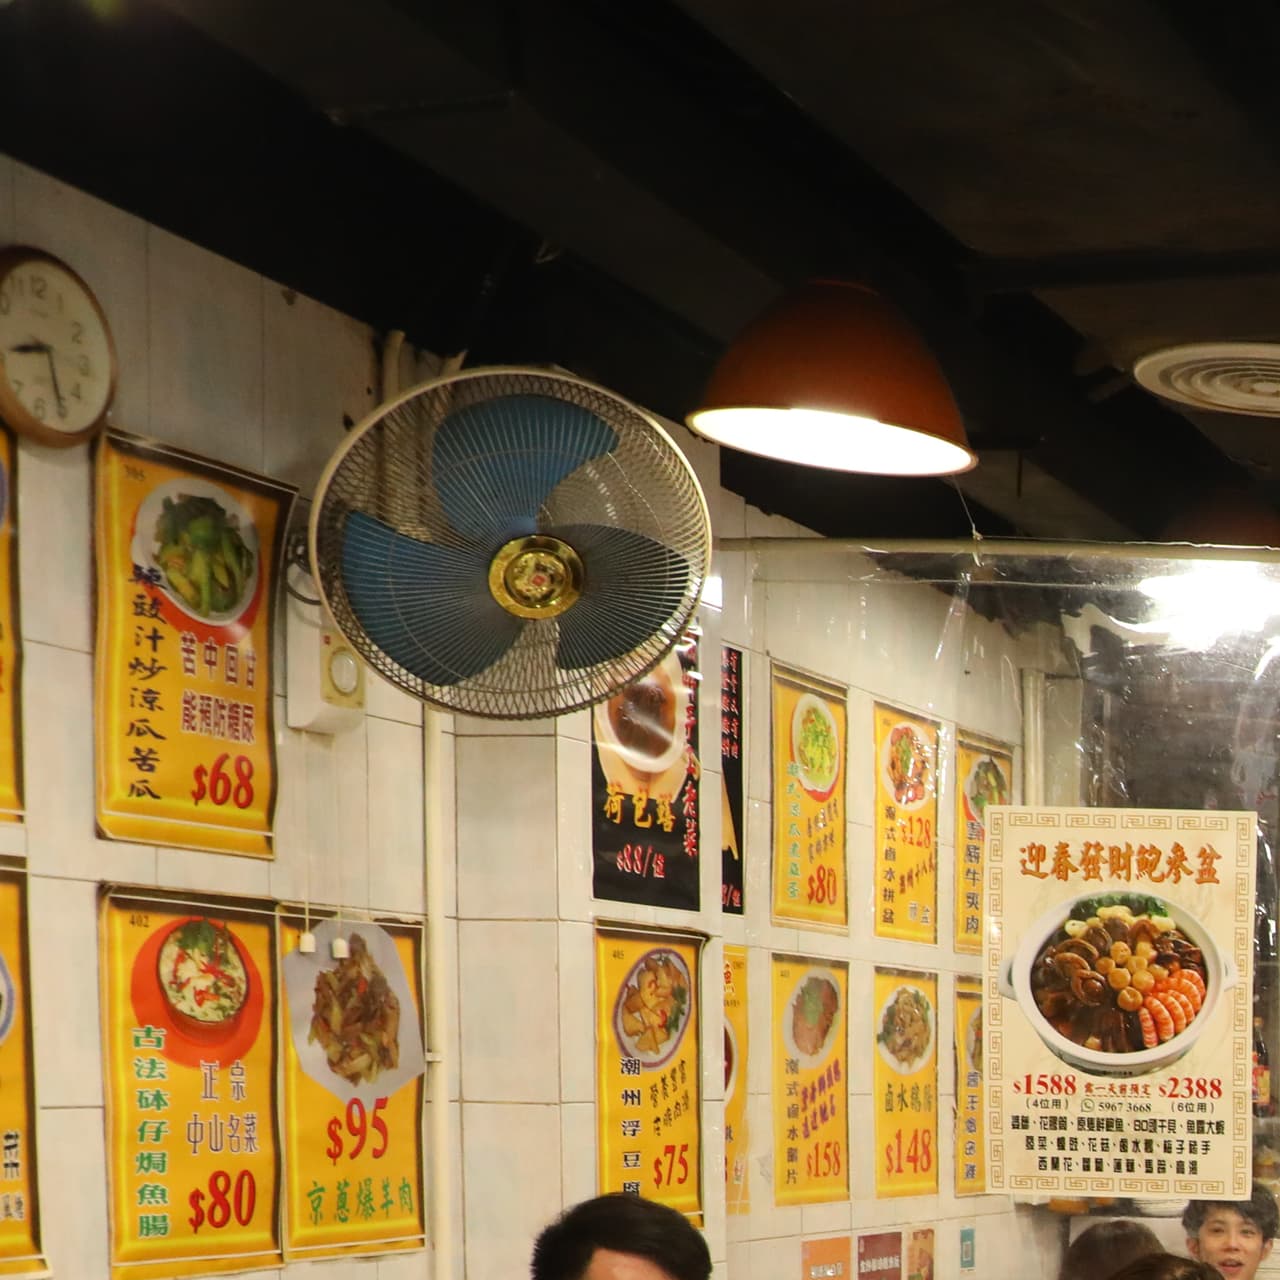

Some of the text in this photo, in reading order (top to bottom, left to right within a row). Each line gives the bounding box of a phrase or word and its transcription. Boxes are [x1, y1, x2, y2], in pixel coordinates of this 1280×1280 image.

[191, 753, 254, 808] $68
[900, 816, 931, 849] $128
[200, 1060, 247, 1101] 正宗
[1013, 1074, 1077, 1096] $1588
[1158, 1077, 1223, 1100] $2388
[1098, 1102, 1151, 1113] 5967 3668
[186, 1113, 259, 1154] 中山名菜
[326, 1096, 389, 1166] $95
[653, 1143, 689, 1189] $75
[806, 1142, 841, 1179] $158
[885, 1128, 932, 1178] $148
[188, 1169, 256, 1234] $80
